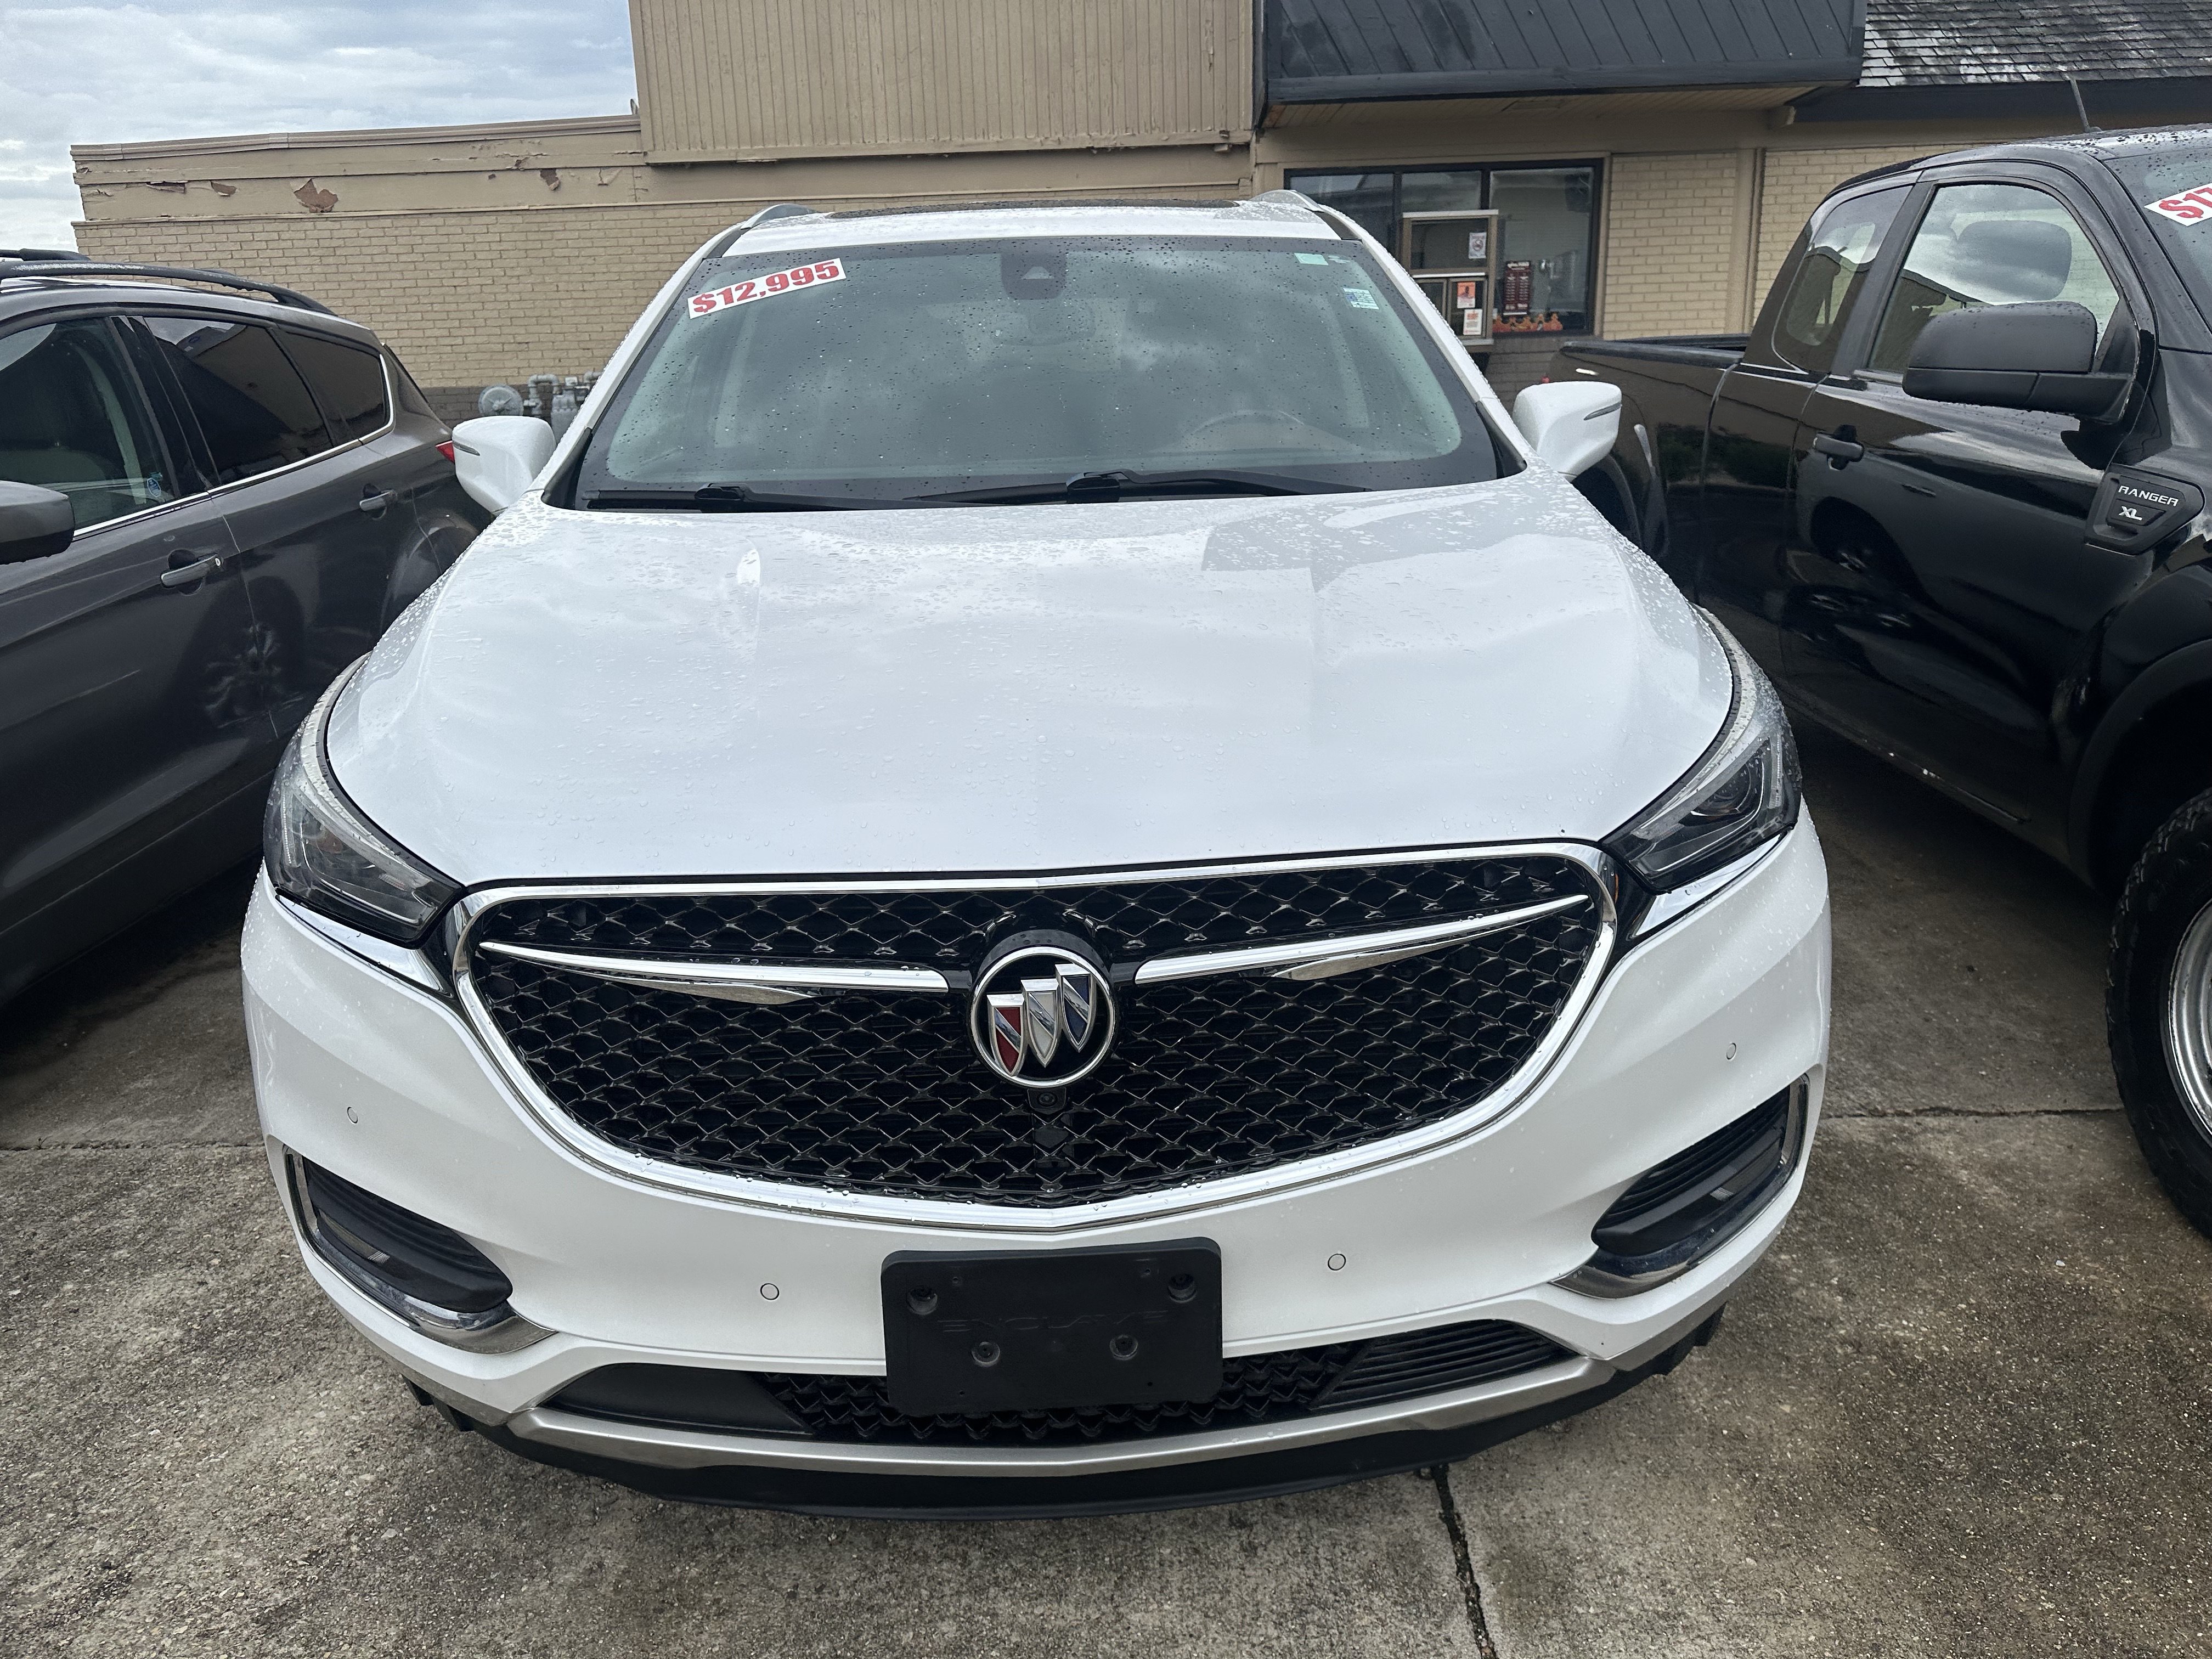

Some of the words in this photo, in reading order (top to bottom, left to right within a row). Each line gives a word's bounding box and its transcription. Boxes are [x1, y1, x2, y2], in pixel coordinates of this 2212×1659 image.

[692, 261, 840, 313] $12,995
[2118, 485, 2180, 507] RANGER
[2118, 505, 2143, 521] XL
